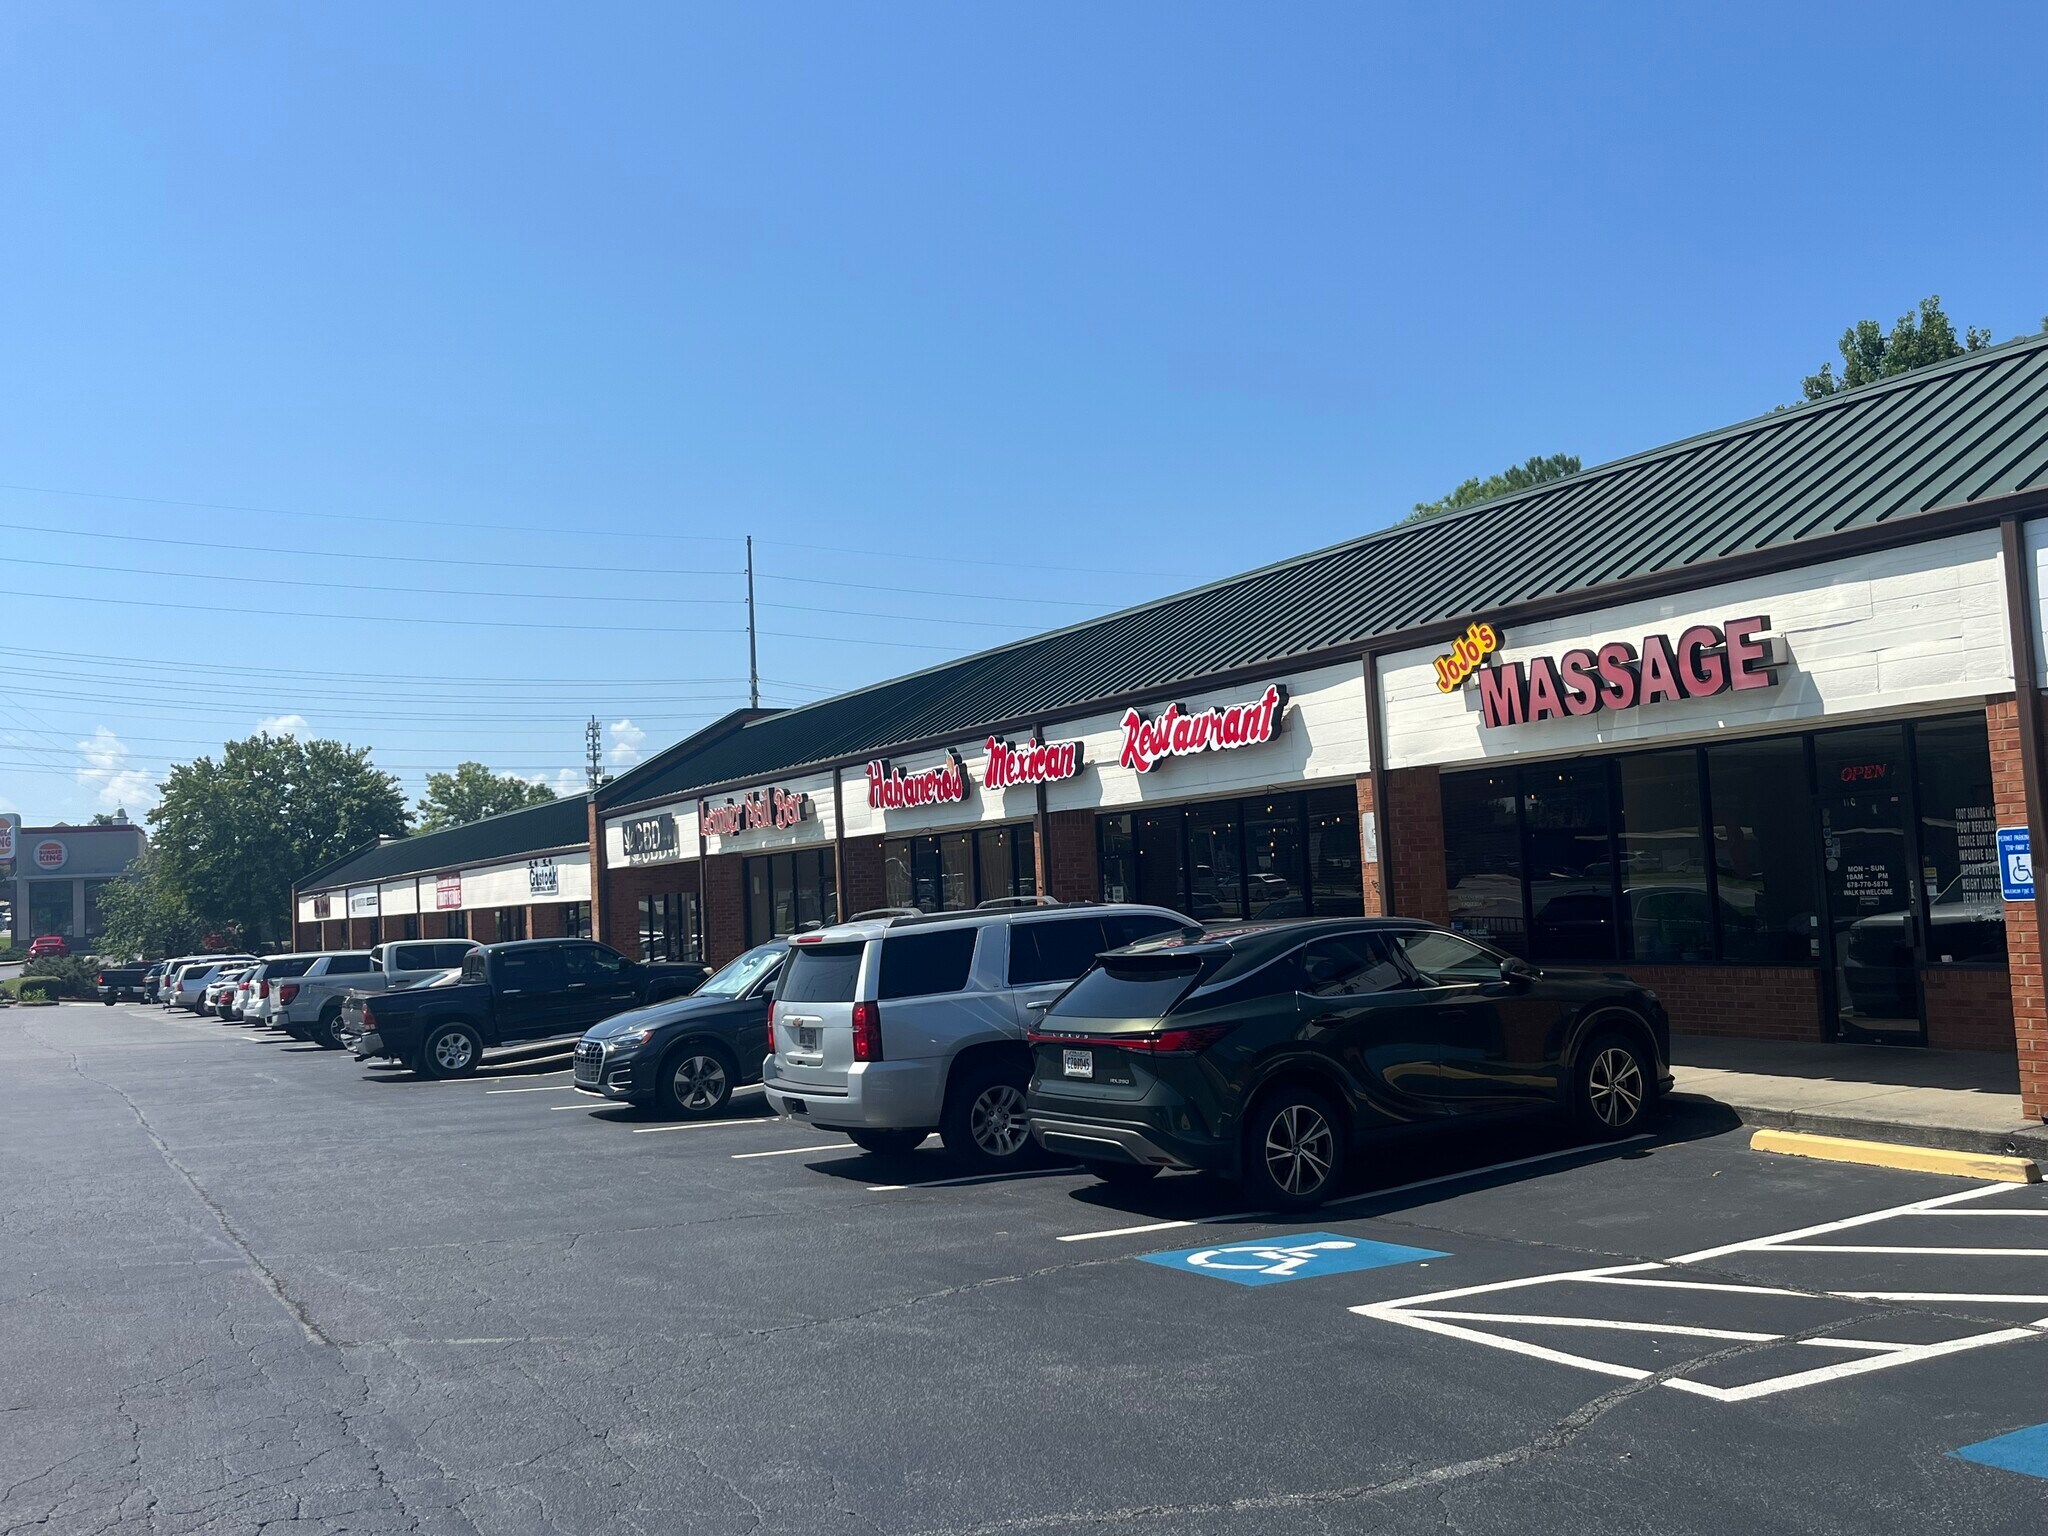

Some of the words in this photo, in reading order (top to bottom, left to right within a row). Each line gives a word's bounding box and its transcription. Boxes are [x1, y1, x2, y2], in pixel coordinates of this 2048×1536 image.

[1434, 622, 1497, 693] JoJo's
[1478, 616, 1773, 729] MASSAGE
[983, 735, 1078, 790] Mexican
[1119, 684, 1282, 773] Restaurant
[1841, 764, 1887, 781] OPEN
[744, 787, 772, 830] Nail
[774, 788, 802, 830] Bar
[1956, 821, 1970, 833] FOOT
[1971, 820, 1997, 832] REFLEXO
[1957, 834, 1976, 847] REDUCE
[1976, 834, 1988, 846] BODY
[1998, 834, 2013, 842] PERMIT
[2013, 834, 2030, 842] PARKIN
[1961, 878, 1980, 890] WEIGHT
[1980, 877, 1993, 890] LOSS
[1866, 888, 1893, 896] WELCOME
[1979, 891, 1992, 903] FOOT
